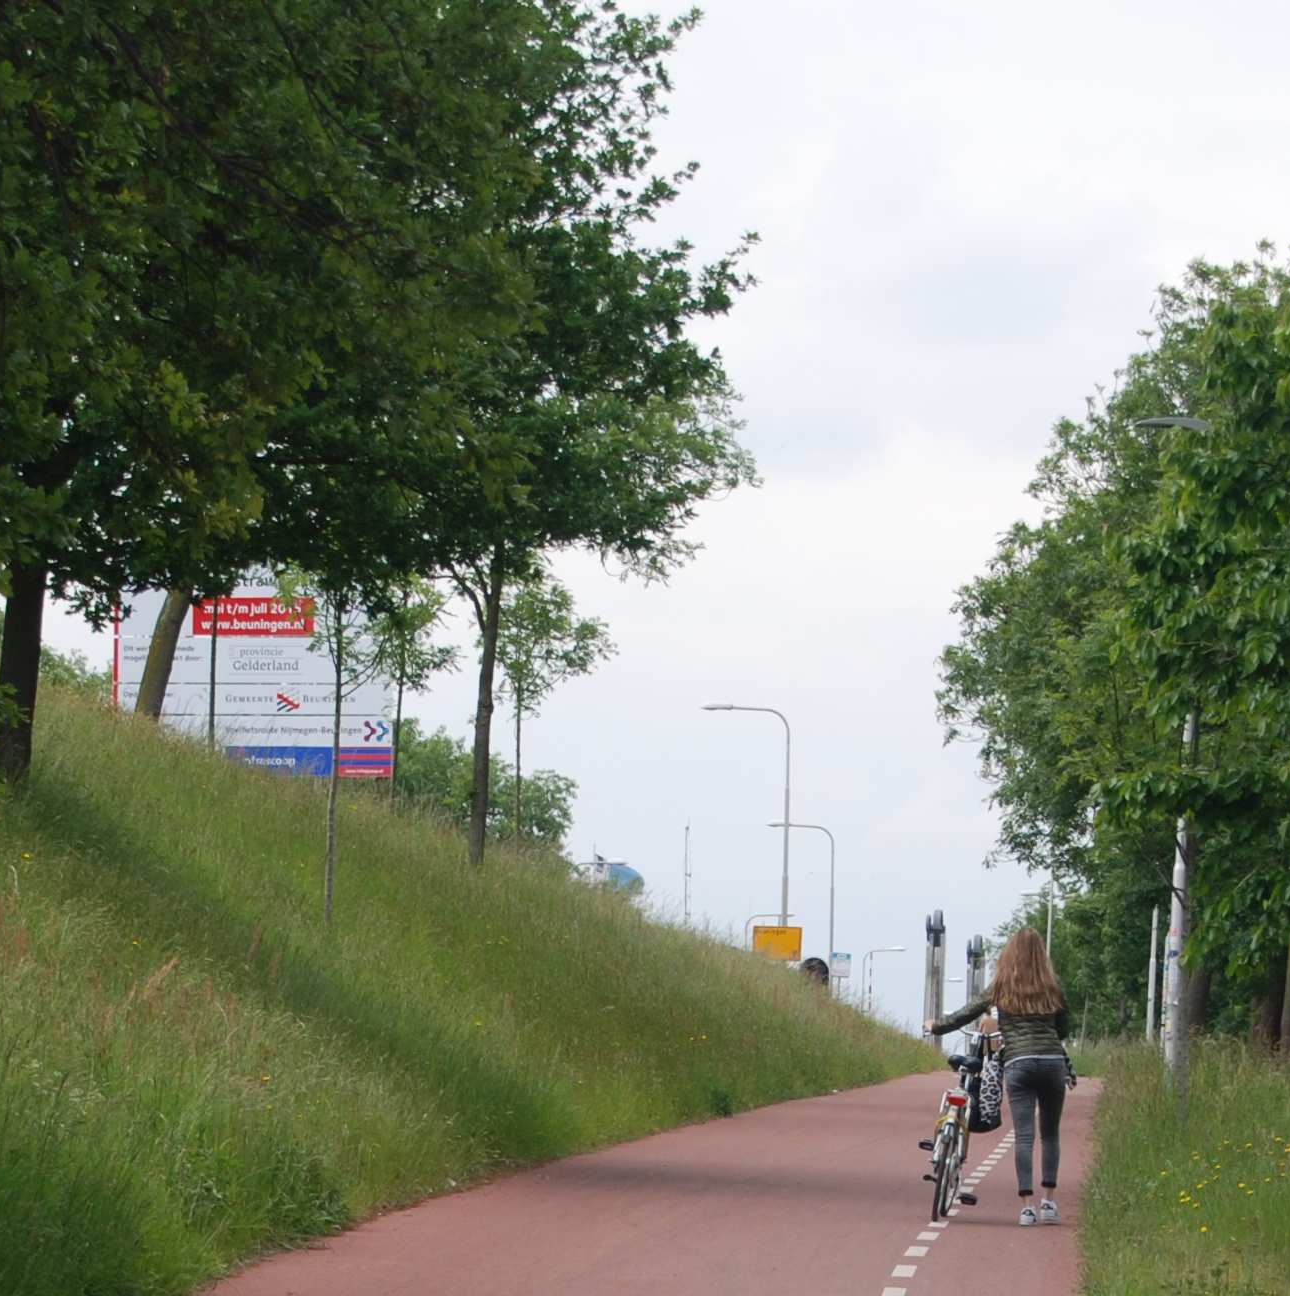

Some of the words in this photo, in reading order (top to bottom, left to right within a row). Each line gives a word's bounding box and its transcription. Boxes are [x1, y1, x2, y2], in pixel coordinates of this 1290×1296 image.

[204, 603, 224, 614] mi
[227, 603, 249, 615] t/m
[250, 602, 268, 617] juli
[239, 647, 284, 658] provincie
[232, 660, 299, 671] Gelderland
